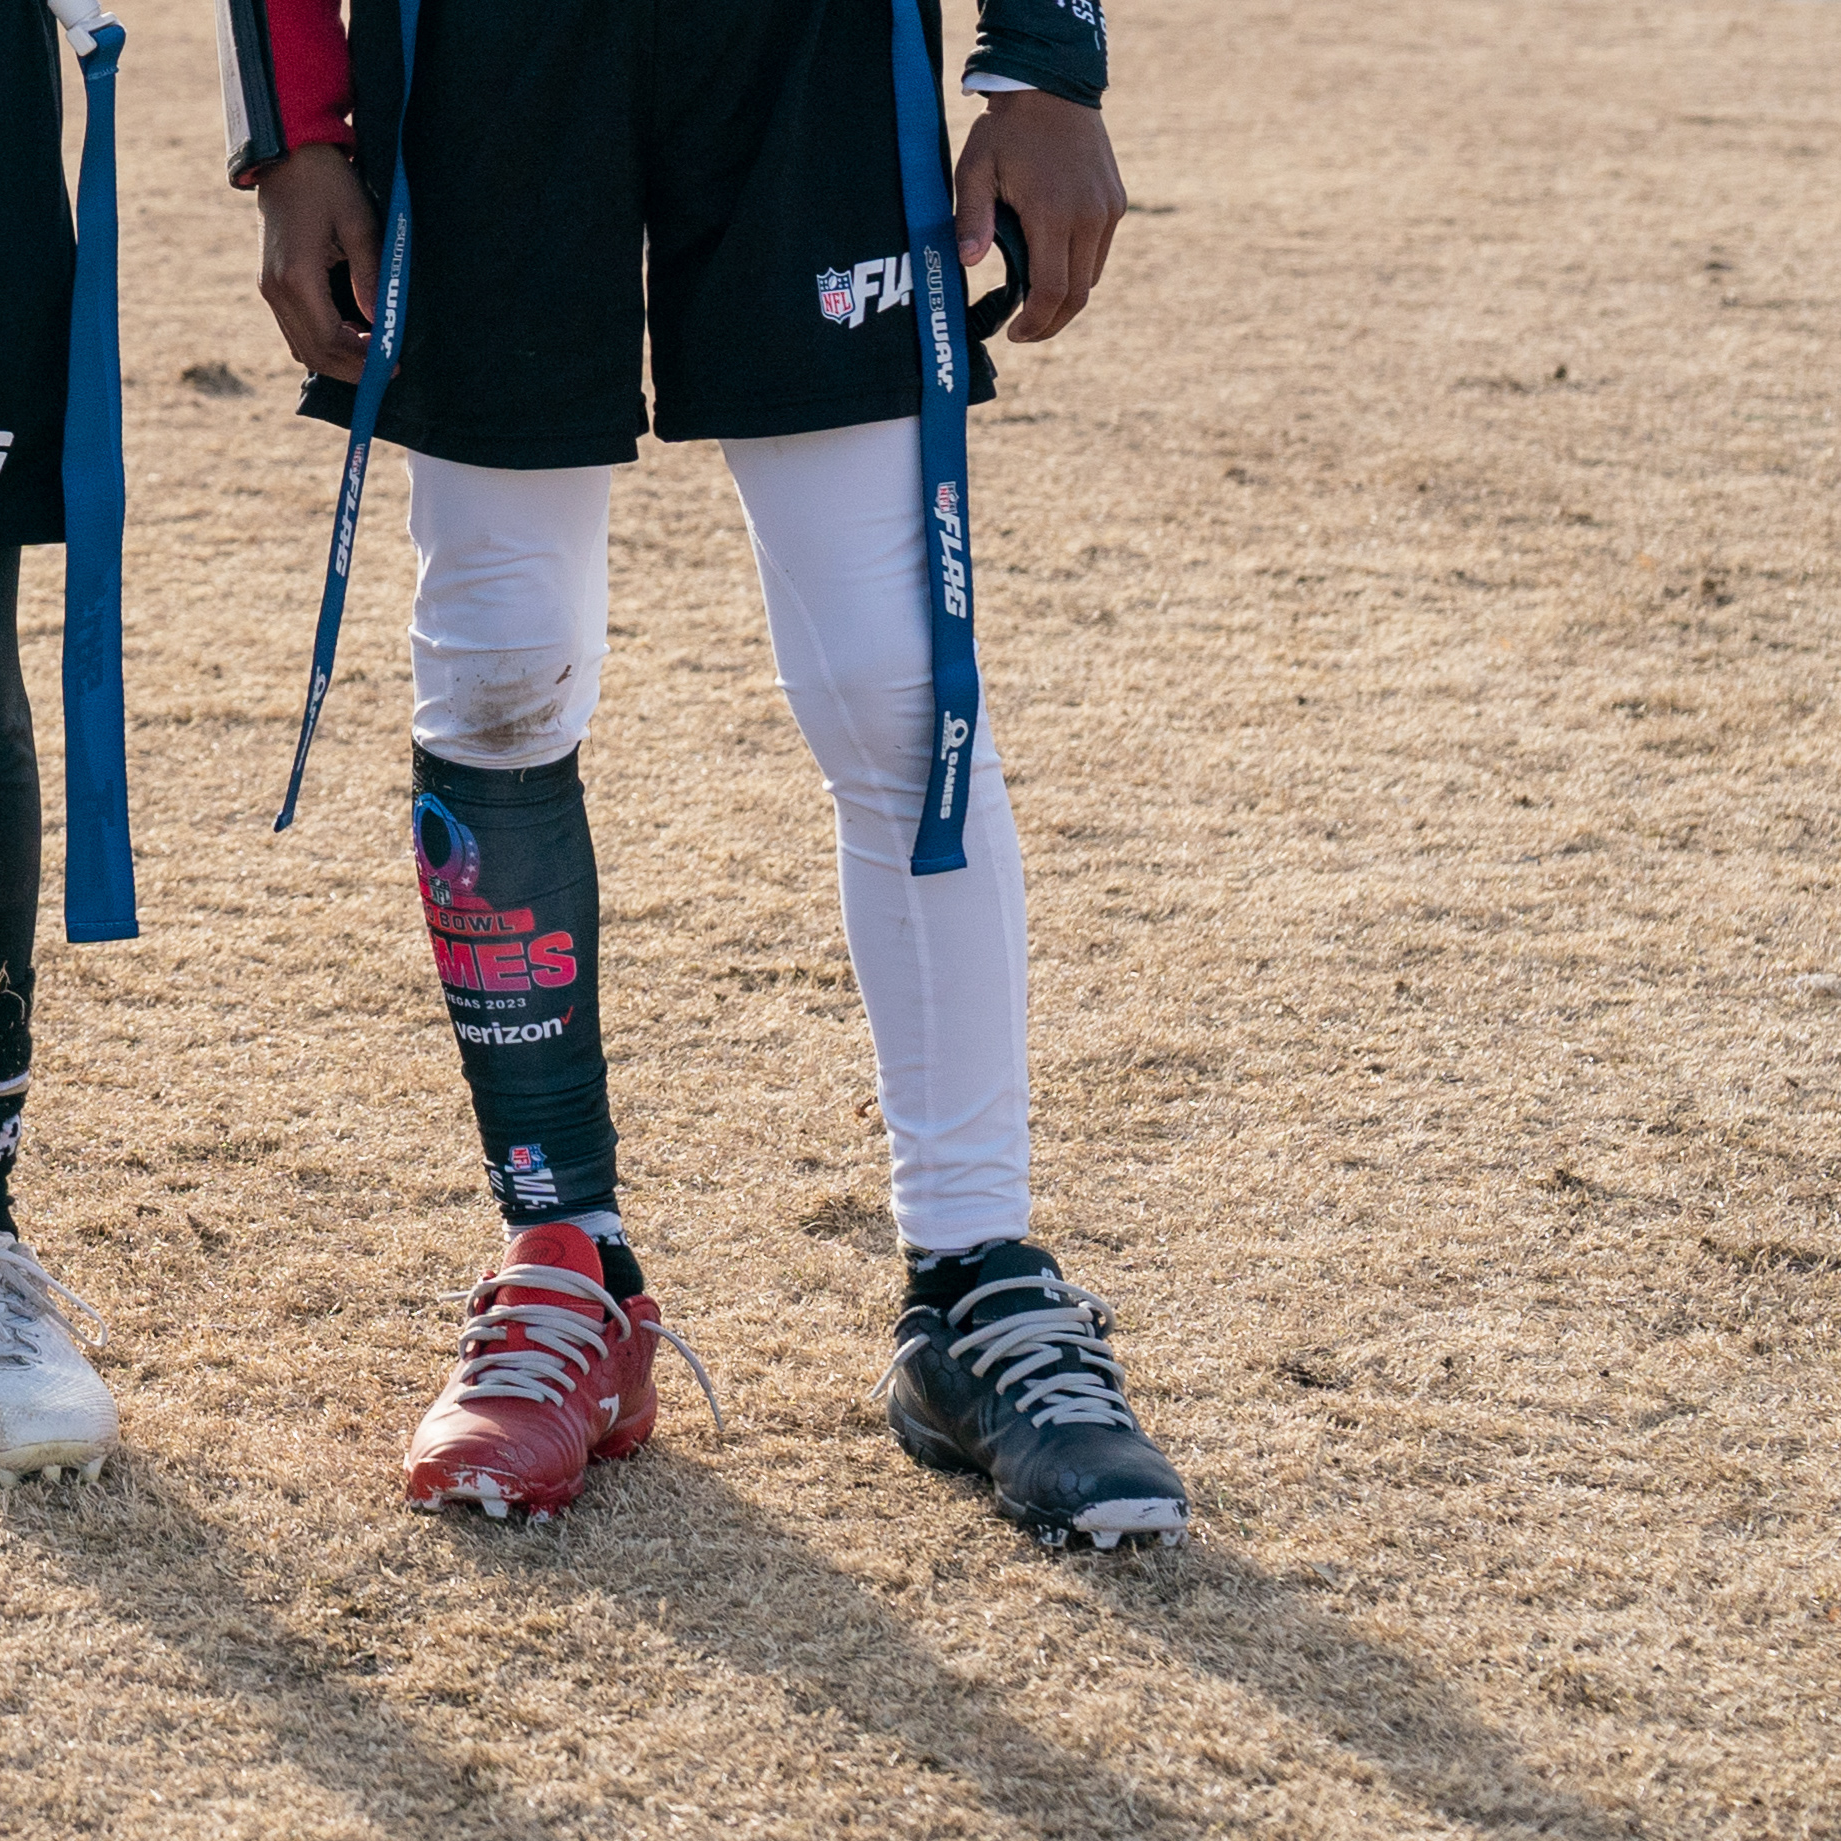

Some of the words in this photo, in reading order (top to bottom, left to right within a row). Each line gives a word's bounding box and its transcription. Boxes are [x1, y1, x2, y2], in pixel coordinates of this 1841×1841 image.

[822, 292, 851, 316] NFL
[923, 246, 954, 393] SUBWAY
[336, 468, 358, 578] FLAG
[934, 506, 966, 619] FLAG
[939, 754, 959, 820] GAMES
[439, 912, 515, 932] BOWL
[485, 998, 527, 1009] 2023
[455, 1017, 563, 1045] verizon
